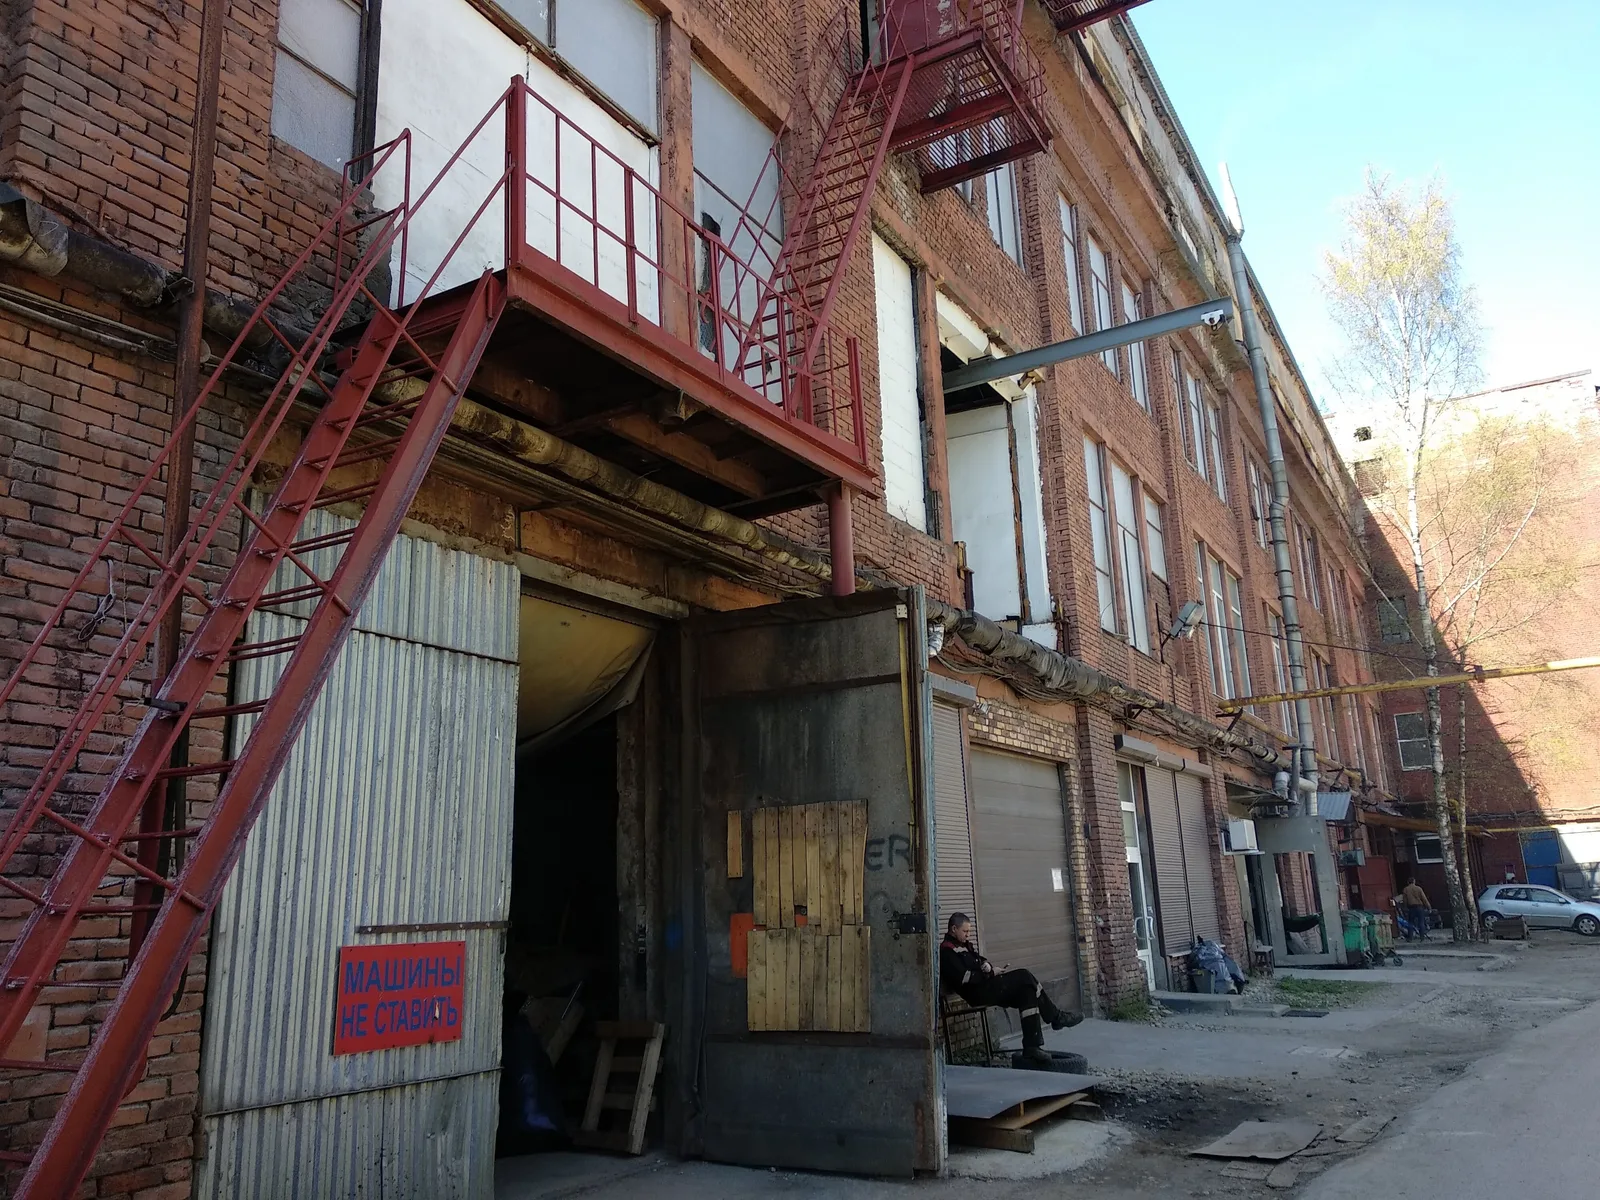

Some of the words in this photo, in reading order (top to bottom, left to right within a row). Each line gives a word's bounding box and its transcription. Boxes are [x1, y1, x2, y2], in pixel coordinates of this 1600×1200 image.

[345, 957, 461, 994] МАШИНЫ
[342, 1004, 368, 1038] НЕ
[374, 997, 458, 1035] СТАВИТЬ
